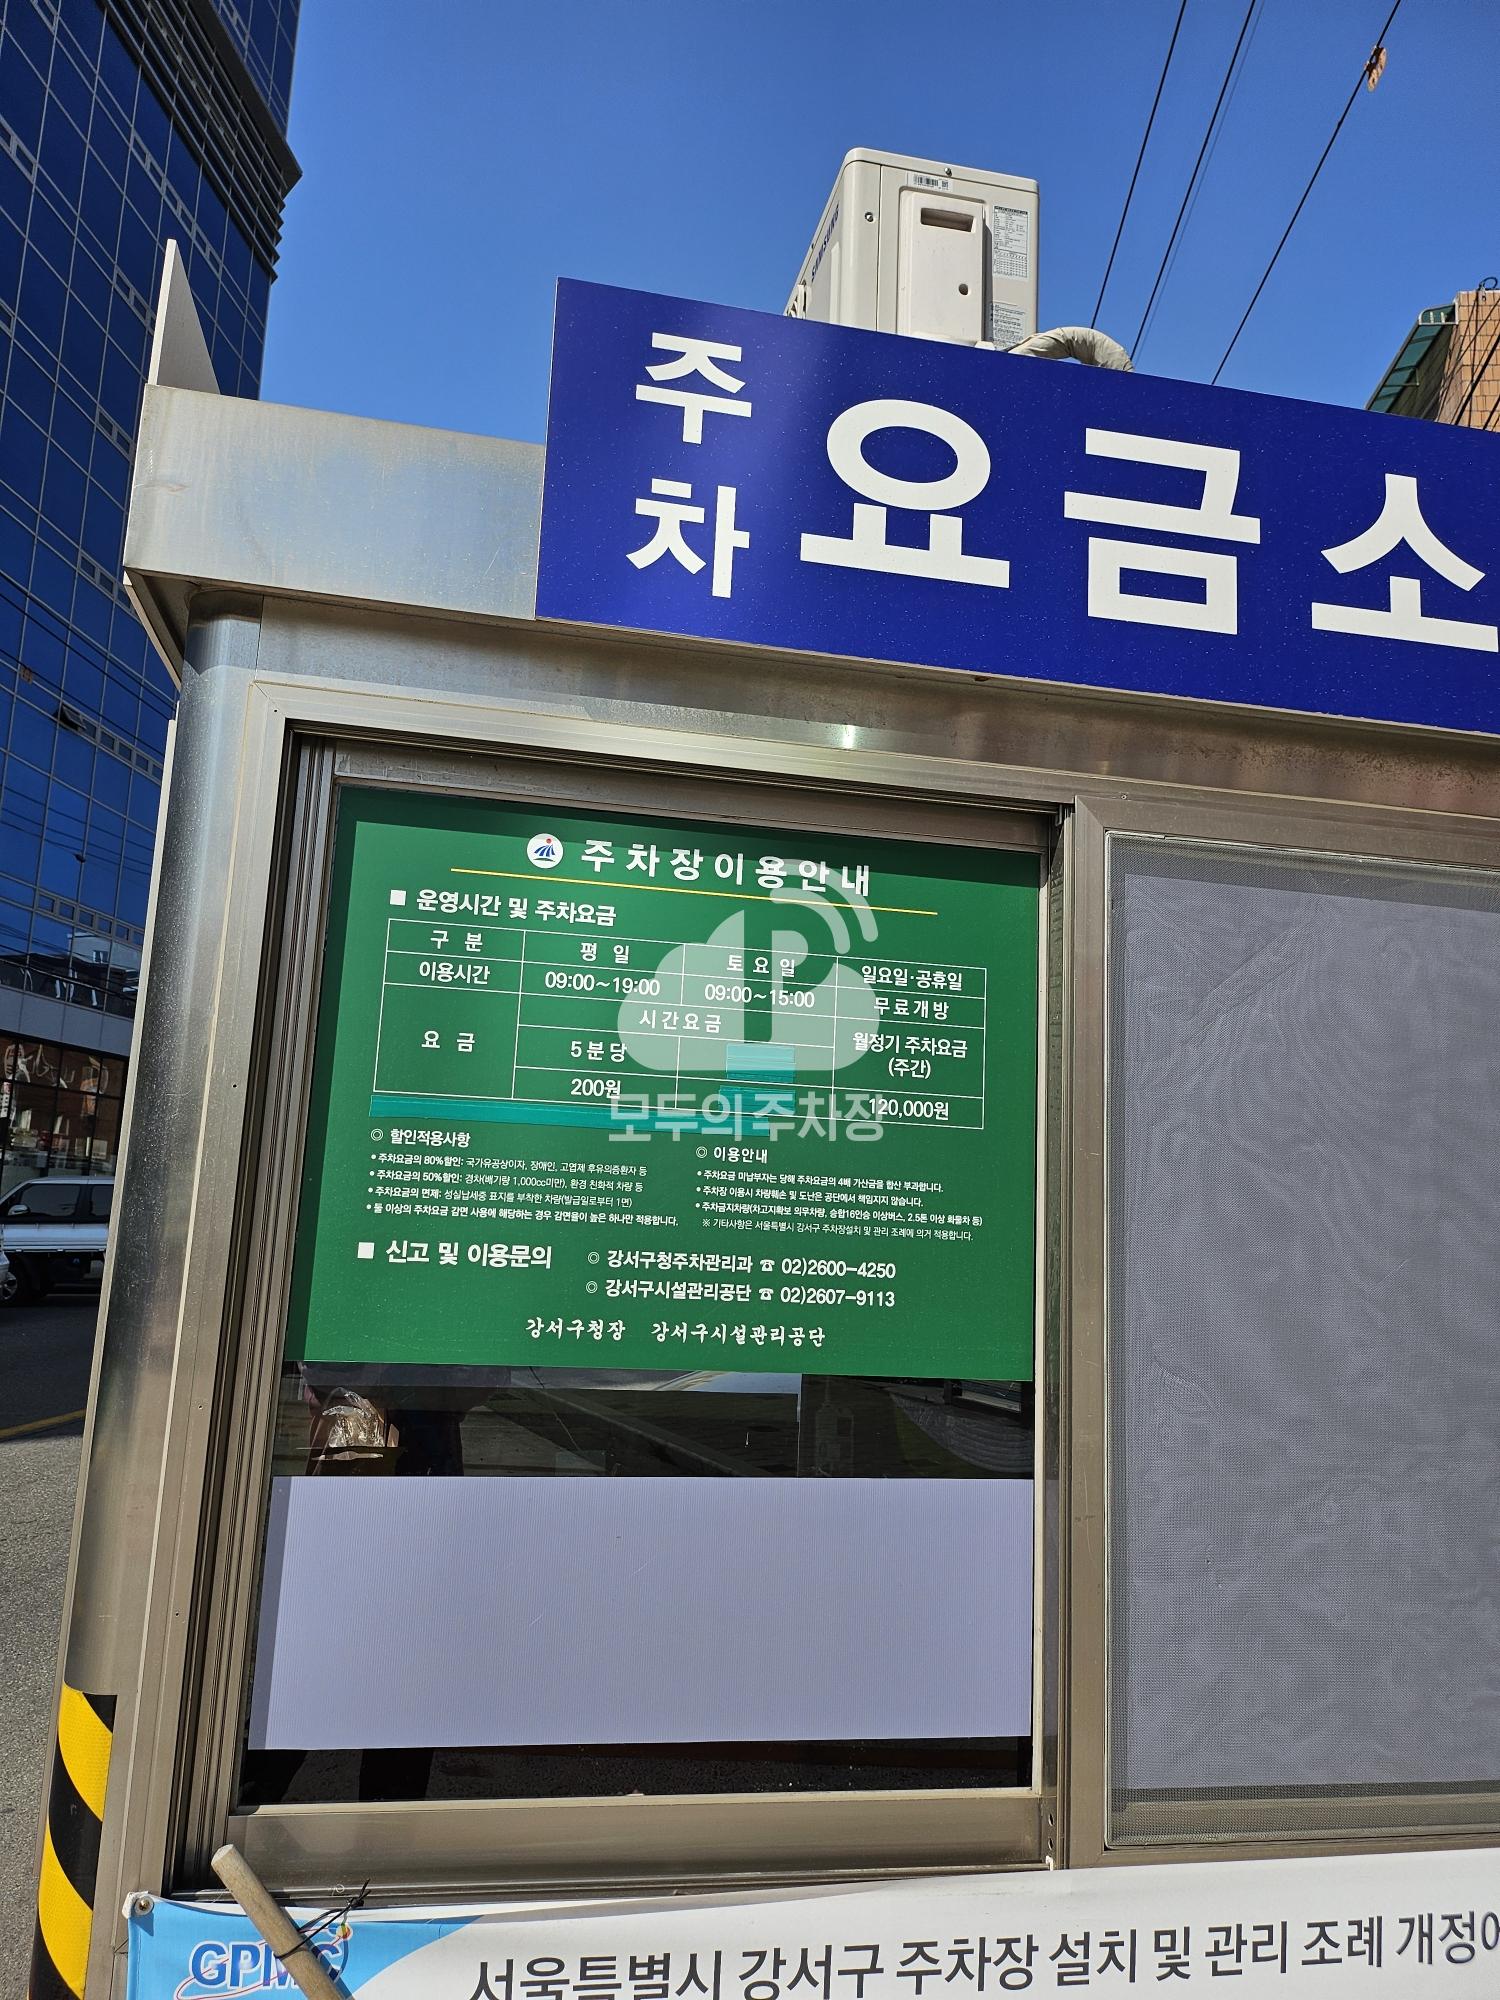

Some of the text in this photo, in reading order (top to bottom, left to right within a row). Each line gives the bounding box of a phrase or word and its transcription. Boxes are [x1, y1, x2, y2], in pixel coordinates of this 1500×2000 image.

[800, 398, 1499, 652] 요금소
[416, 889, 616, 927] 운영시간 및 주차요금
[419, 961, 490, 984] 이용시간
[545, 971, 661, 996] 09:00~19:00
[704, 984, 815, 1008] 09:00~15:00
[852, 1032, 968, 1059] 월정기 주차요금
[888, 1058, 931, 1080] (주간)
[570, 1079, 621, 1100] 200원
[868, 1097, 950, 1121] 120,000원
[390, 1128, 471, 1147] 할인적용사항
[378, 1152, 421, 1165] 주차요금의
[559, 1162, 585, 1172] 고엽제
[639, 1166, 647, 1176] 등
[713, 1146, 768, 1164] 이용안내
[374, 1185, 419, 1198] 주차요금의
[421, 1188, 441, 1199] 면제:
[376, 1169, 420, 1181] 주차요금의
[464, 1173, 510, 1185] 경차(배기량
[569, 1178, 586, 1189] 환경
[589, 1179, 613, 1190] 친화적
[615, 1181, 633, 1191] 차량
[634, 1182, 643, 1192] 등
[703, 1169, 735, 1181] 주차요금
[737, 1171, 777, 1183] 미납부자는
[779, 1174, 795, 1184] 당해
[796, 1174, 836, 1186] 주차요금의
[852, 1178, 883, 1189] 가산금을
[885, 1179, 901, 1190] 합산
[903, 1181, 943, 1192] 부과합니다.
[702, 1185, 727, 1196] 주차장
[729, 1187, 753, 1198] 이용시
[788, 1190, 796, 1200] 및
[798, 1190, 822, 1201] 도난은
[824, 1192, 855, 1203] 공단에서
[857, 1193, 888, 1205] 책임지지
[890, 1195, 923, 1207] 않습니다.
[385, 1203, 411, 1214] 이상의
[413, 1204, 448, 1216] 주차요금
[450, 1206, 468, 1216] 감면
[498, 1208, 532, 1219] 해당하는
[534, 1209, 551, 1220] 경우
[608, 1213, 633, 1224] 하나만
[635, 1214, 678, 1226] 적용합니다.
[829, 1208, 870, 1220] 승합16인승
[907, 1212, 927, 1223] 2.5톤
[929, 1213, 945, 1224] 이상
[971, 1216, 982, 1226] 등)
[712, 1218, 752, 1229] 기타사항은
[754, 1220, 794, 1232] 서울특별시
[796, 1222, 820, 1233] 강서구
[821, 1223, 861, 1235] 주차장설치
[863, 1226, 871, 1235] 및
[872, 1226, 888, 1236] 관리
[915, 1228, 931, 1238] 의거
[933, 1229, 973, 1241] 적용합니다.
[386, 1240, 552, 1269] 신고 및 이용문의
[607, 1249, 896, 1279] 강서구청주차관리과 02)2600-4250
[605, 1278, 895, 1307] 강서구시설관리공단 02)2607-9113
[525, 1317, 826, 1348] 강서구청장 강서구시설관리공단
[739, 1944, 884, 2000] 강서구
[896, 1933, 1039, 1996] 주차장
[1049, 1929, 1137, 1986] 설치
[1153, 1927, 1191, 1981] 및
[1204, 1921, 1287, 1977] 관리
[1302, 1915, 1382, 1968] 조례
